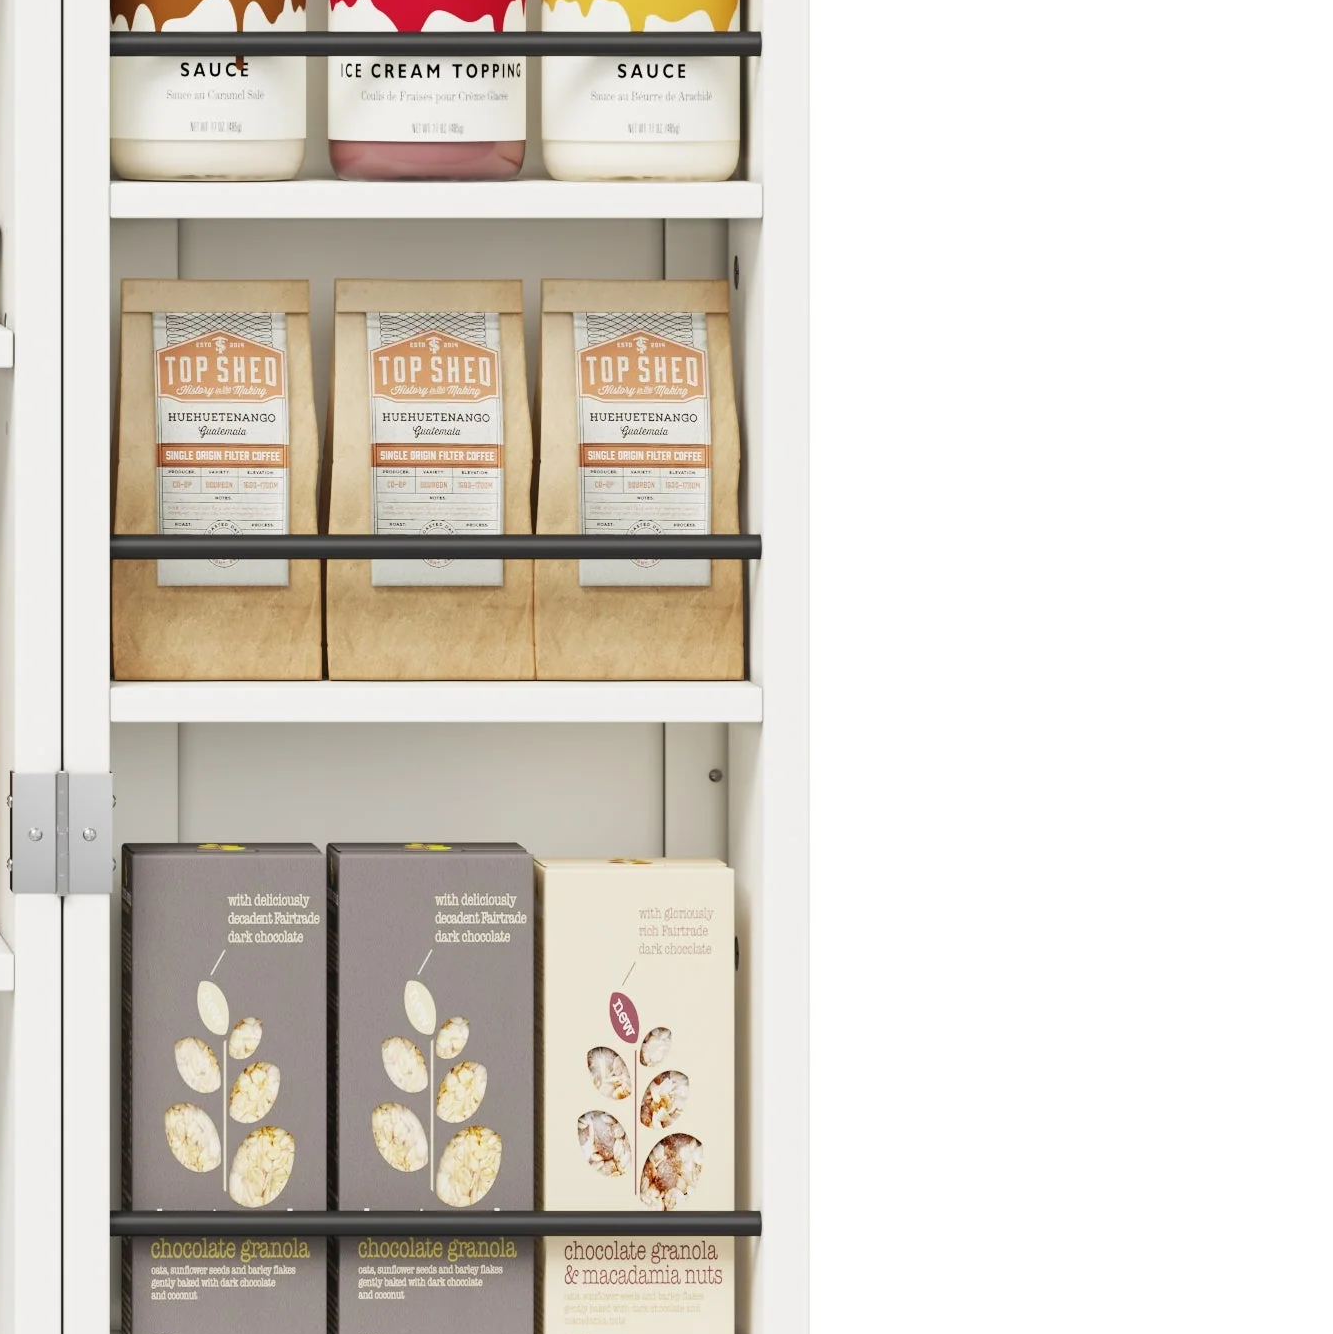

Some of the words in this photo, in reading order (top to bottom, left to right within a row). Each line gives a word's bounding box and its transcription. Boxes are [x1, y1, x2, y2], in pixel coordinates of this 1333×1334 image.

[180, 62, 249, 77] SAUCE
[341, 63, 362, 78] ICE
[370, 63, 440, 78] CREAM
[452, 63, 521, 78] TOPPING
[617, 63, 686, 79] SAUCE
[165, 356, 209, 385] TOP
[216, 356, 277, 386] SHED
[379, 356, 423, 385] TOP
[430, 356, 491, 386] SHED
[587, 356, 631, 385] TOP
[638, 356, 699, 386] SHED
[168, 412, 276, 423] HUEHUETENANGO
[198, 426, 247, 437] Guatemala
[166, 451, 193, 461] SINGLE
[196, 451, 223, 461] ORIGIN
[224, 451, 250, 461] FILTER
[252, 451, 280, 461] COFFEE
[228, 893, 251, 906] with
[254, 893, 310, 908] deliciously
[228, 912, 271, 925] decadent
[274, 912, 320, 925] Fairtrade
[639, 907, 661, 920] with
[664, 907, 714, 923] gloriously
[228, 930, 252, 943] dark
[255, 930, 304, 943] chocolate
[639, 925, 658, 938] rich
[661, 925, 708, 938] Fairtrade
[639, 943, 662, 955] dark
[664, 943, 712, 955] chocolate
[612, 998, 636, 1038] new
[150, 1237, 236, 1259] chocolate
[240, 1237, 310, 1263] granola
[358, 1237, 443, 1259] chocolate
[448, 1237, 517, 1262] granola
[564, 1240, 646, 1261] chocolate
[651, 1240, 718, 1264] granola
[564, 1266, 579, 1284] &
[582, 1265, 681, 1285] macadamia
[684, 1267, 723, 1285] nuts
